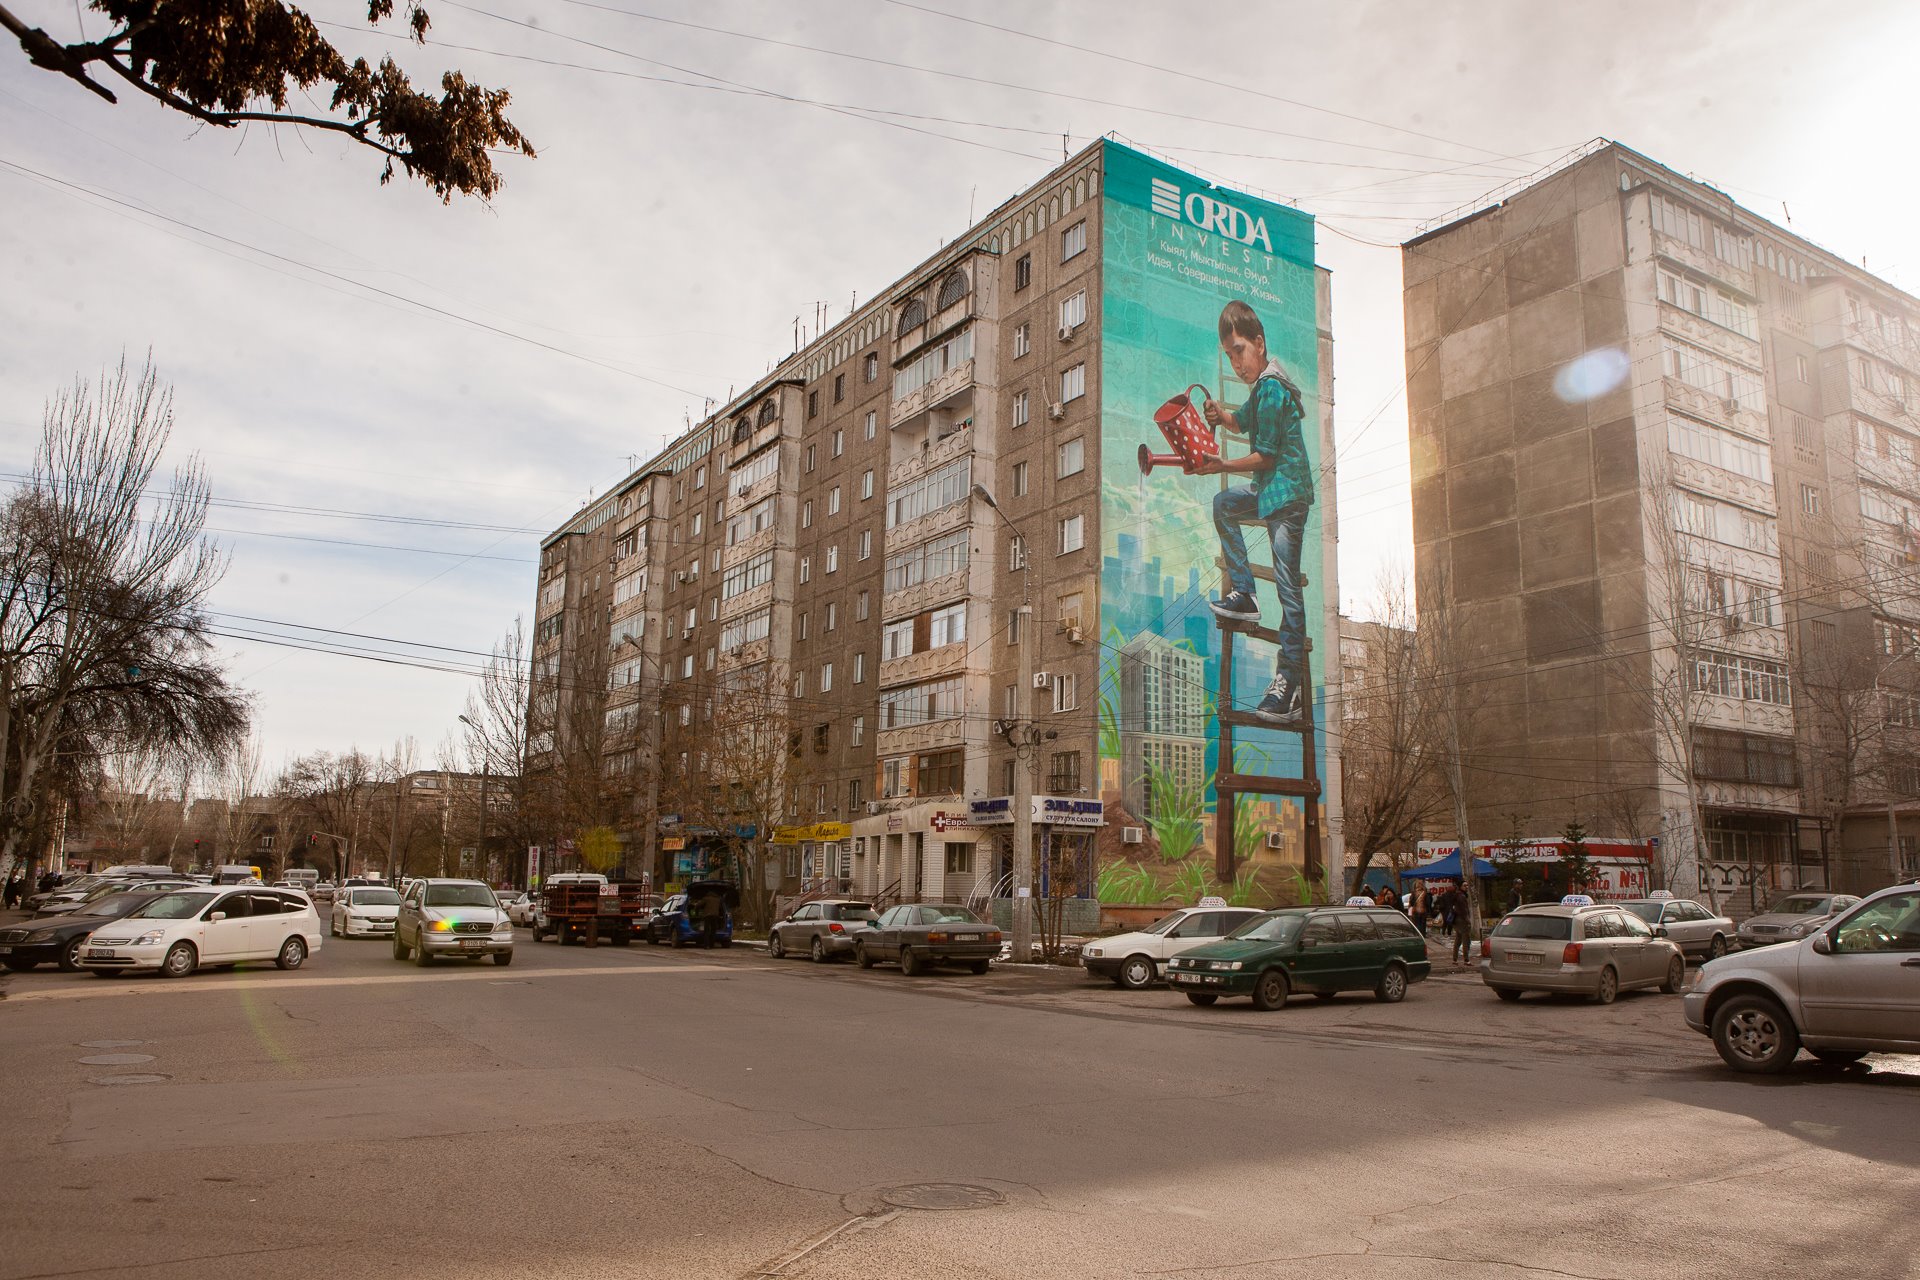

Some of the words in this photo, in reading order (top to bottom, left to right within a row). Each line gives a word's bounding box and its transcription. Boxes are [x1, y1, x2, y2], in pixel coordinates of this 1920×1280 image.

[1151, 215, 1273, 271] INVEST
[1184, 192, 1273, 254] ORDA
[1177, 262, 1248, 295] Совершенство,
